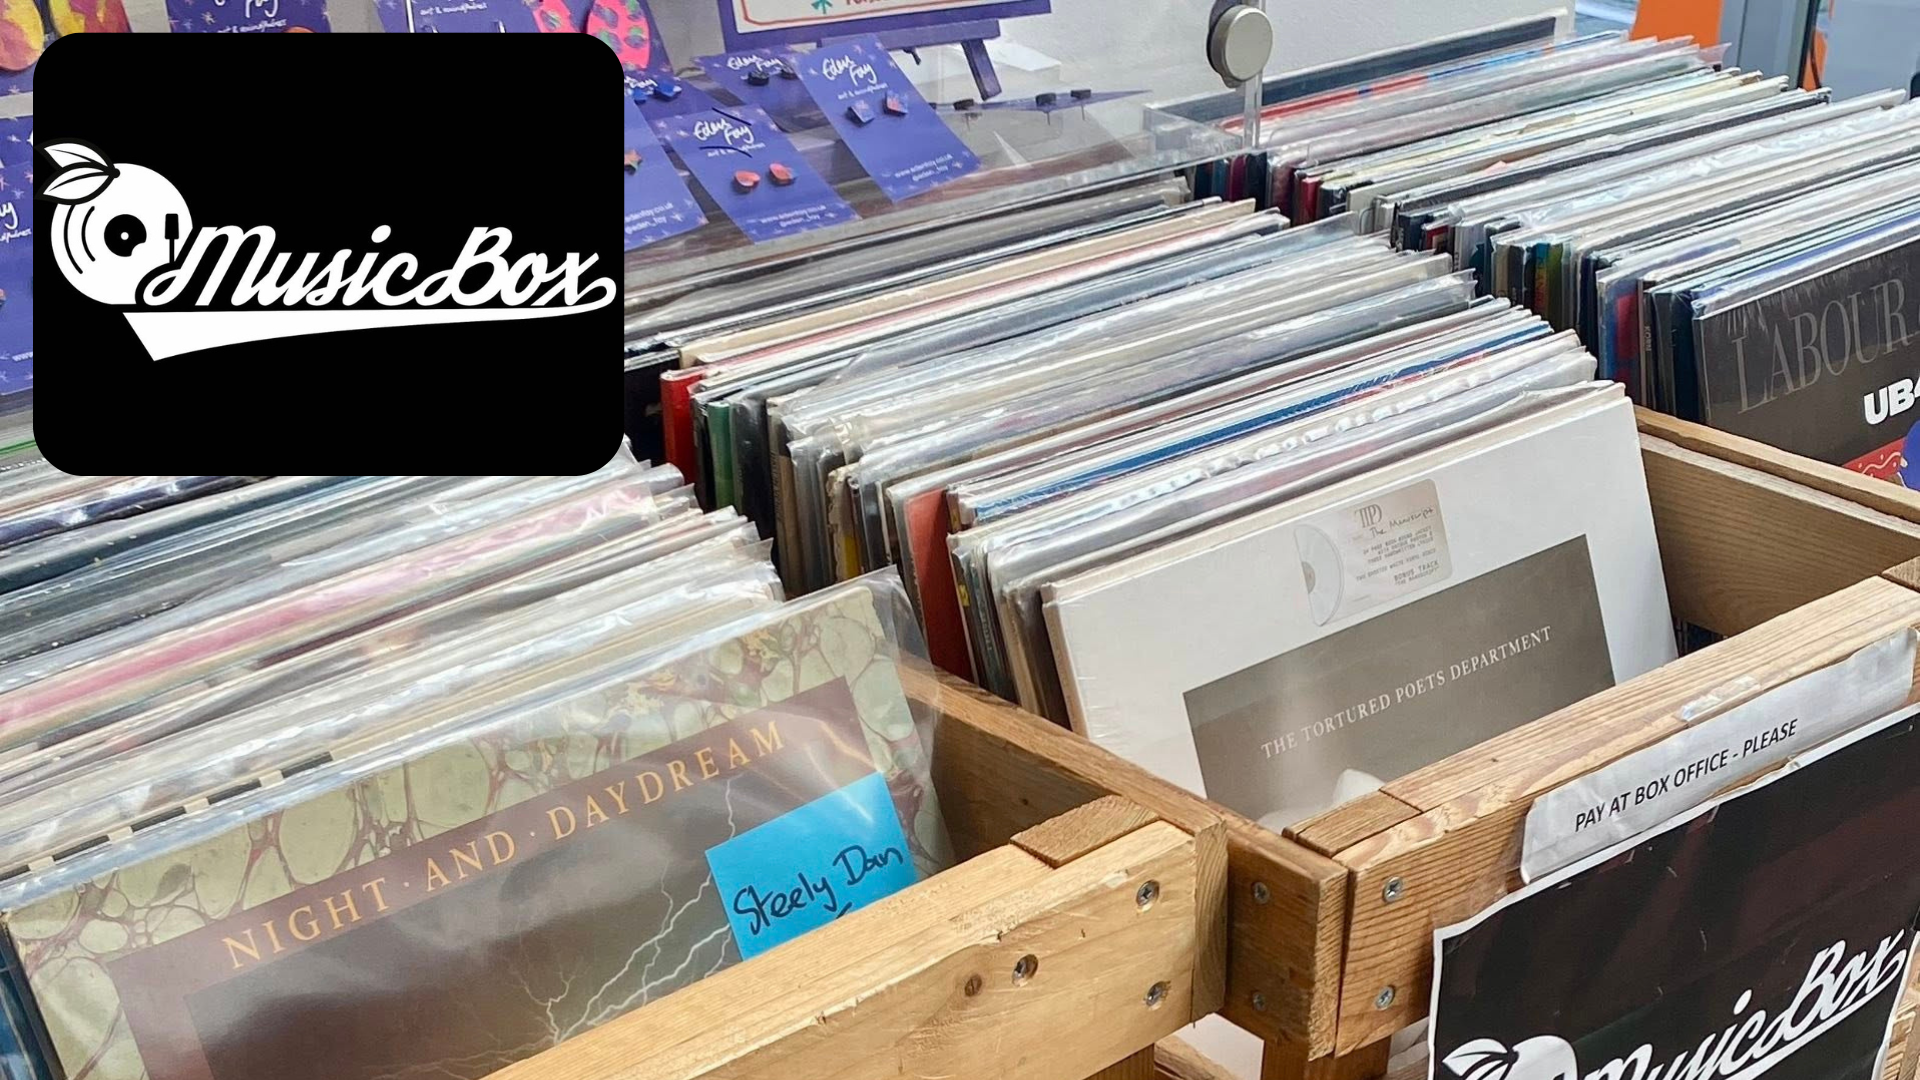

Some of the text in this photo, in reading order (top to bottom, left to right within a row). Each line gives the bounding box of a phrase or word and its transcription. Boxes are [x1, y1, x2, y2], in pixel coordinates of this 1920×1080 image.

[727, 55, 763, 70] Eden
[822, 54, 878, 86] Eden Fay
[694, 117, 755, 145] Eden Fay
[1731, 277, 1910, 414] LABOUR
[1394, 560, 1438, 581] BONUS TRACK
[1261, 626, 1551, 759] THE TORTURED POETS DEPARTMENT
[1575, 804, 1606, 832] PAY
[1608, 792, 1632, 817] AT
[1634, 775, 1670, 806] BOX
[1673, 749, 1729, 788] OFFICE
[1742, 719, 1798, 758] PLEASE
[222, 720, 785, 970] NIGHT AND DAYDREAM
[733, 845, 904, 936] Steely Dan
